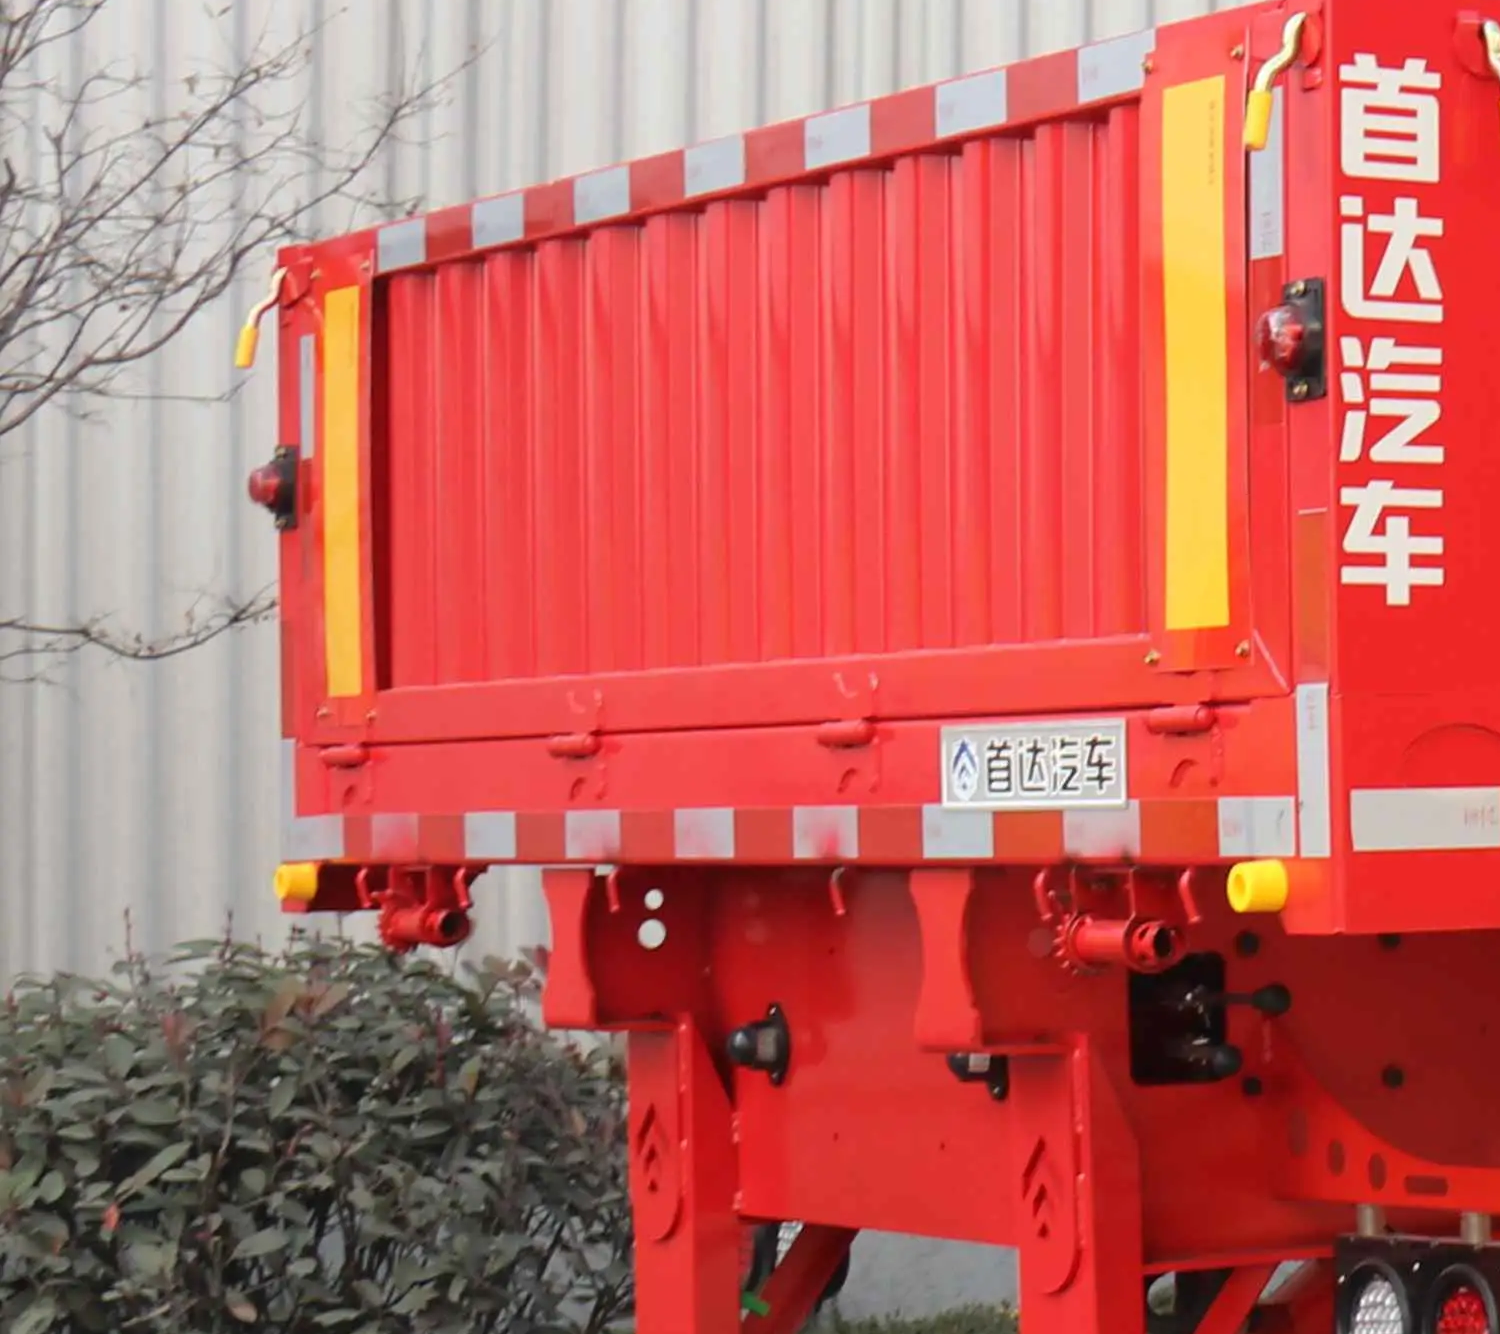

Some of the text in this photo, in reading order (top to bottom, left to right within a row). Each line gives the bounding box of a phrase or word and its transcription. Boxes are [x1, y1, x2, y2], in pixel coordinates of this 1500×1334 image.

[1338, 53, 1445, 607] 首达汽车
[987, 734, 1115, 794] 首达汽车
